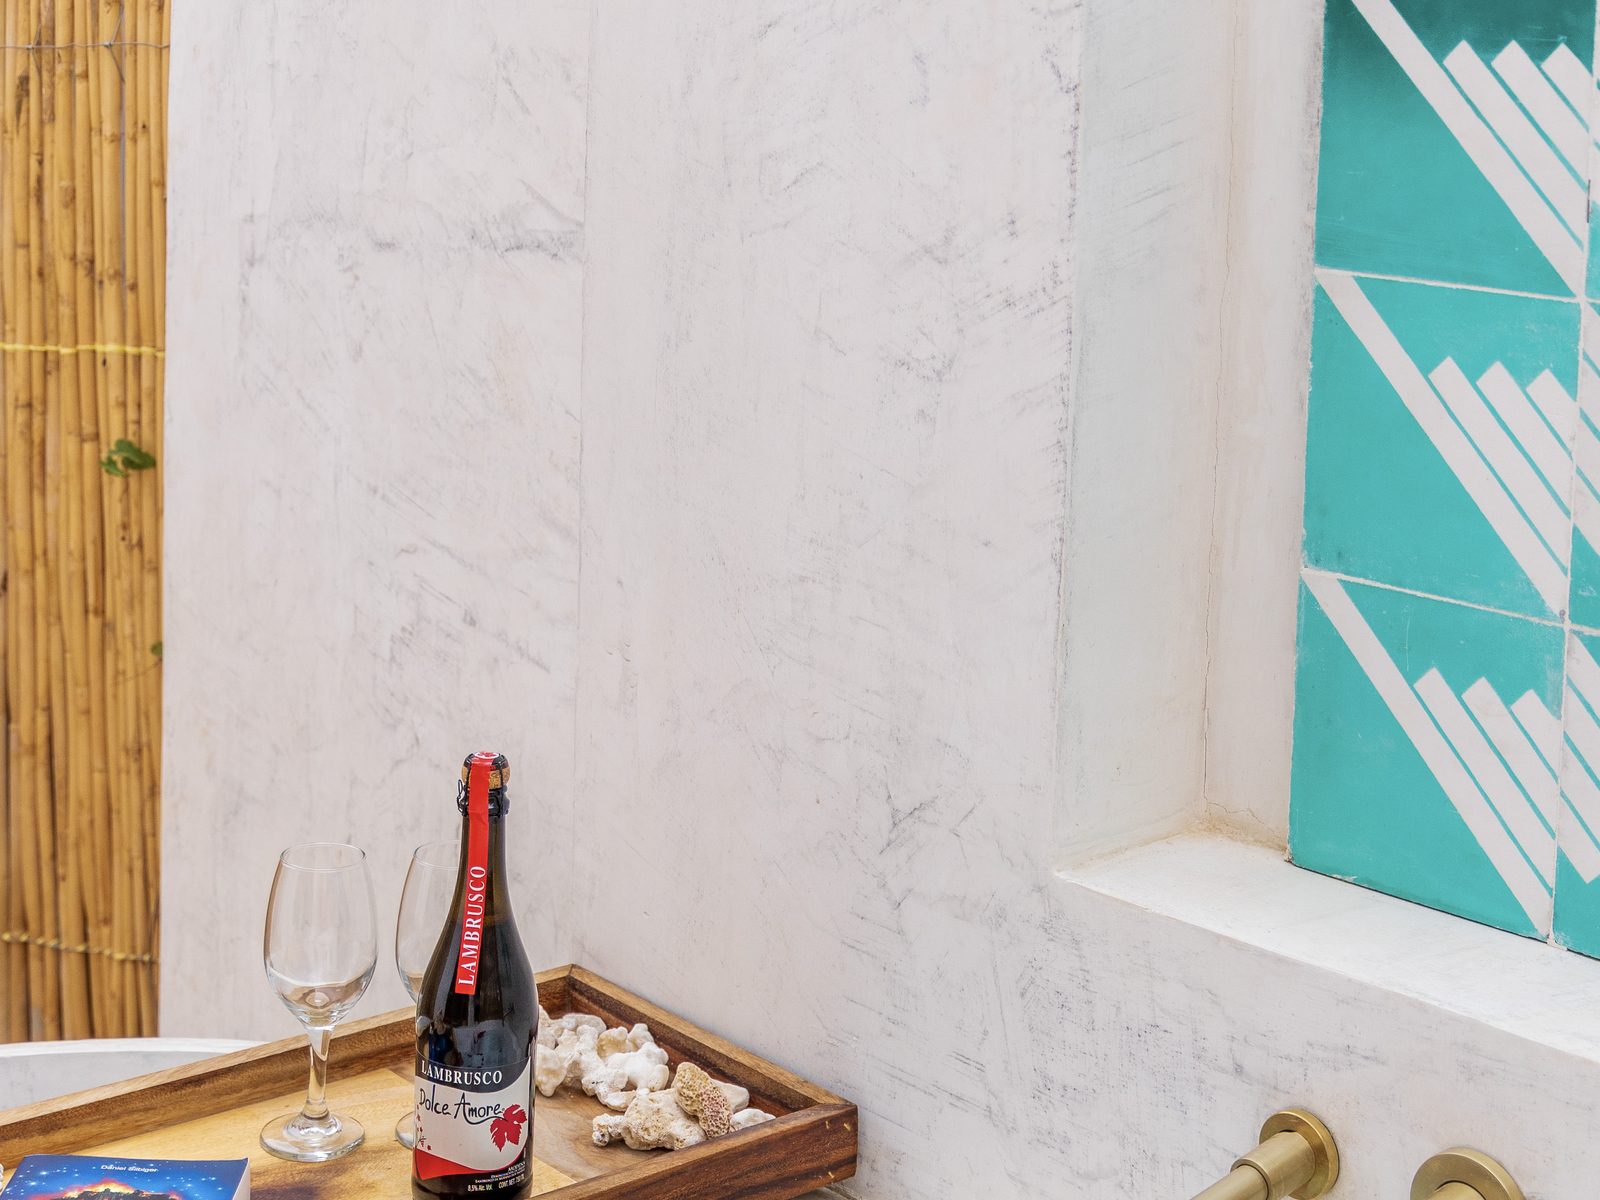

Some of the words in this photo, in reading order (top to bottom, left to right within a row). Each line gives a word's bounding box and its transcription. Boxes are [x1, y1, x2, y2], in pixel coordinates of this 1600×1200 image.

[458, 866, 486, 986] LAMBRUSCO
[421, 1059, 503, 1086] LAMBRUSCO
[419, 1084, 451, 1115] Dolce
[454, 1092, 507, 1125] Amore
